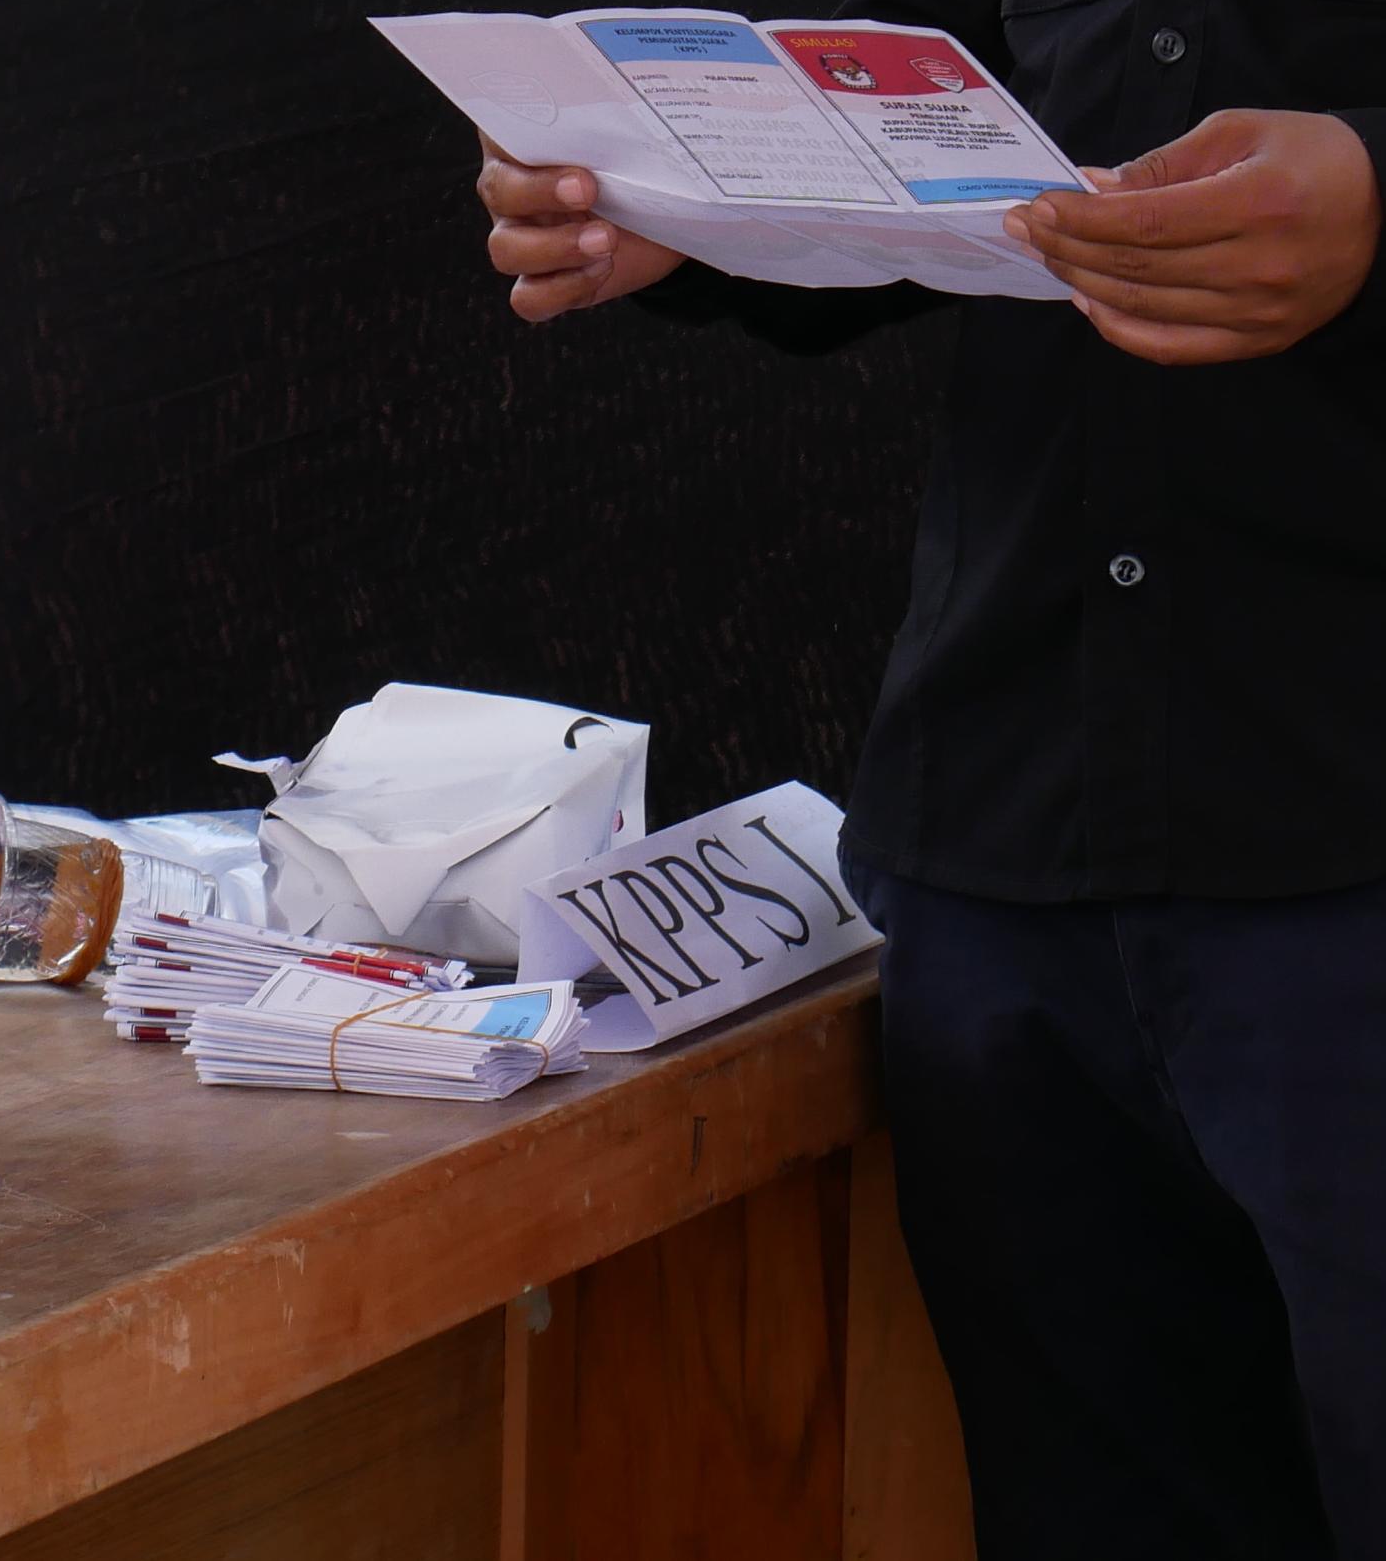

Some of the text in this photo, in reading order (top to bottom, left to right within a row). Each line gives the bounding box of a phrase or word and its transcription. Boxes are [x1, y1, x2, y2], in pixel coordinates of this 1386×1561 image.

[789, 38, 857, 48] SIMULASI
[880, 101, 973, 113] SURAT SUARA
[557, 832, 811, 1007] KPPS
